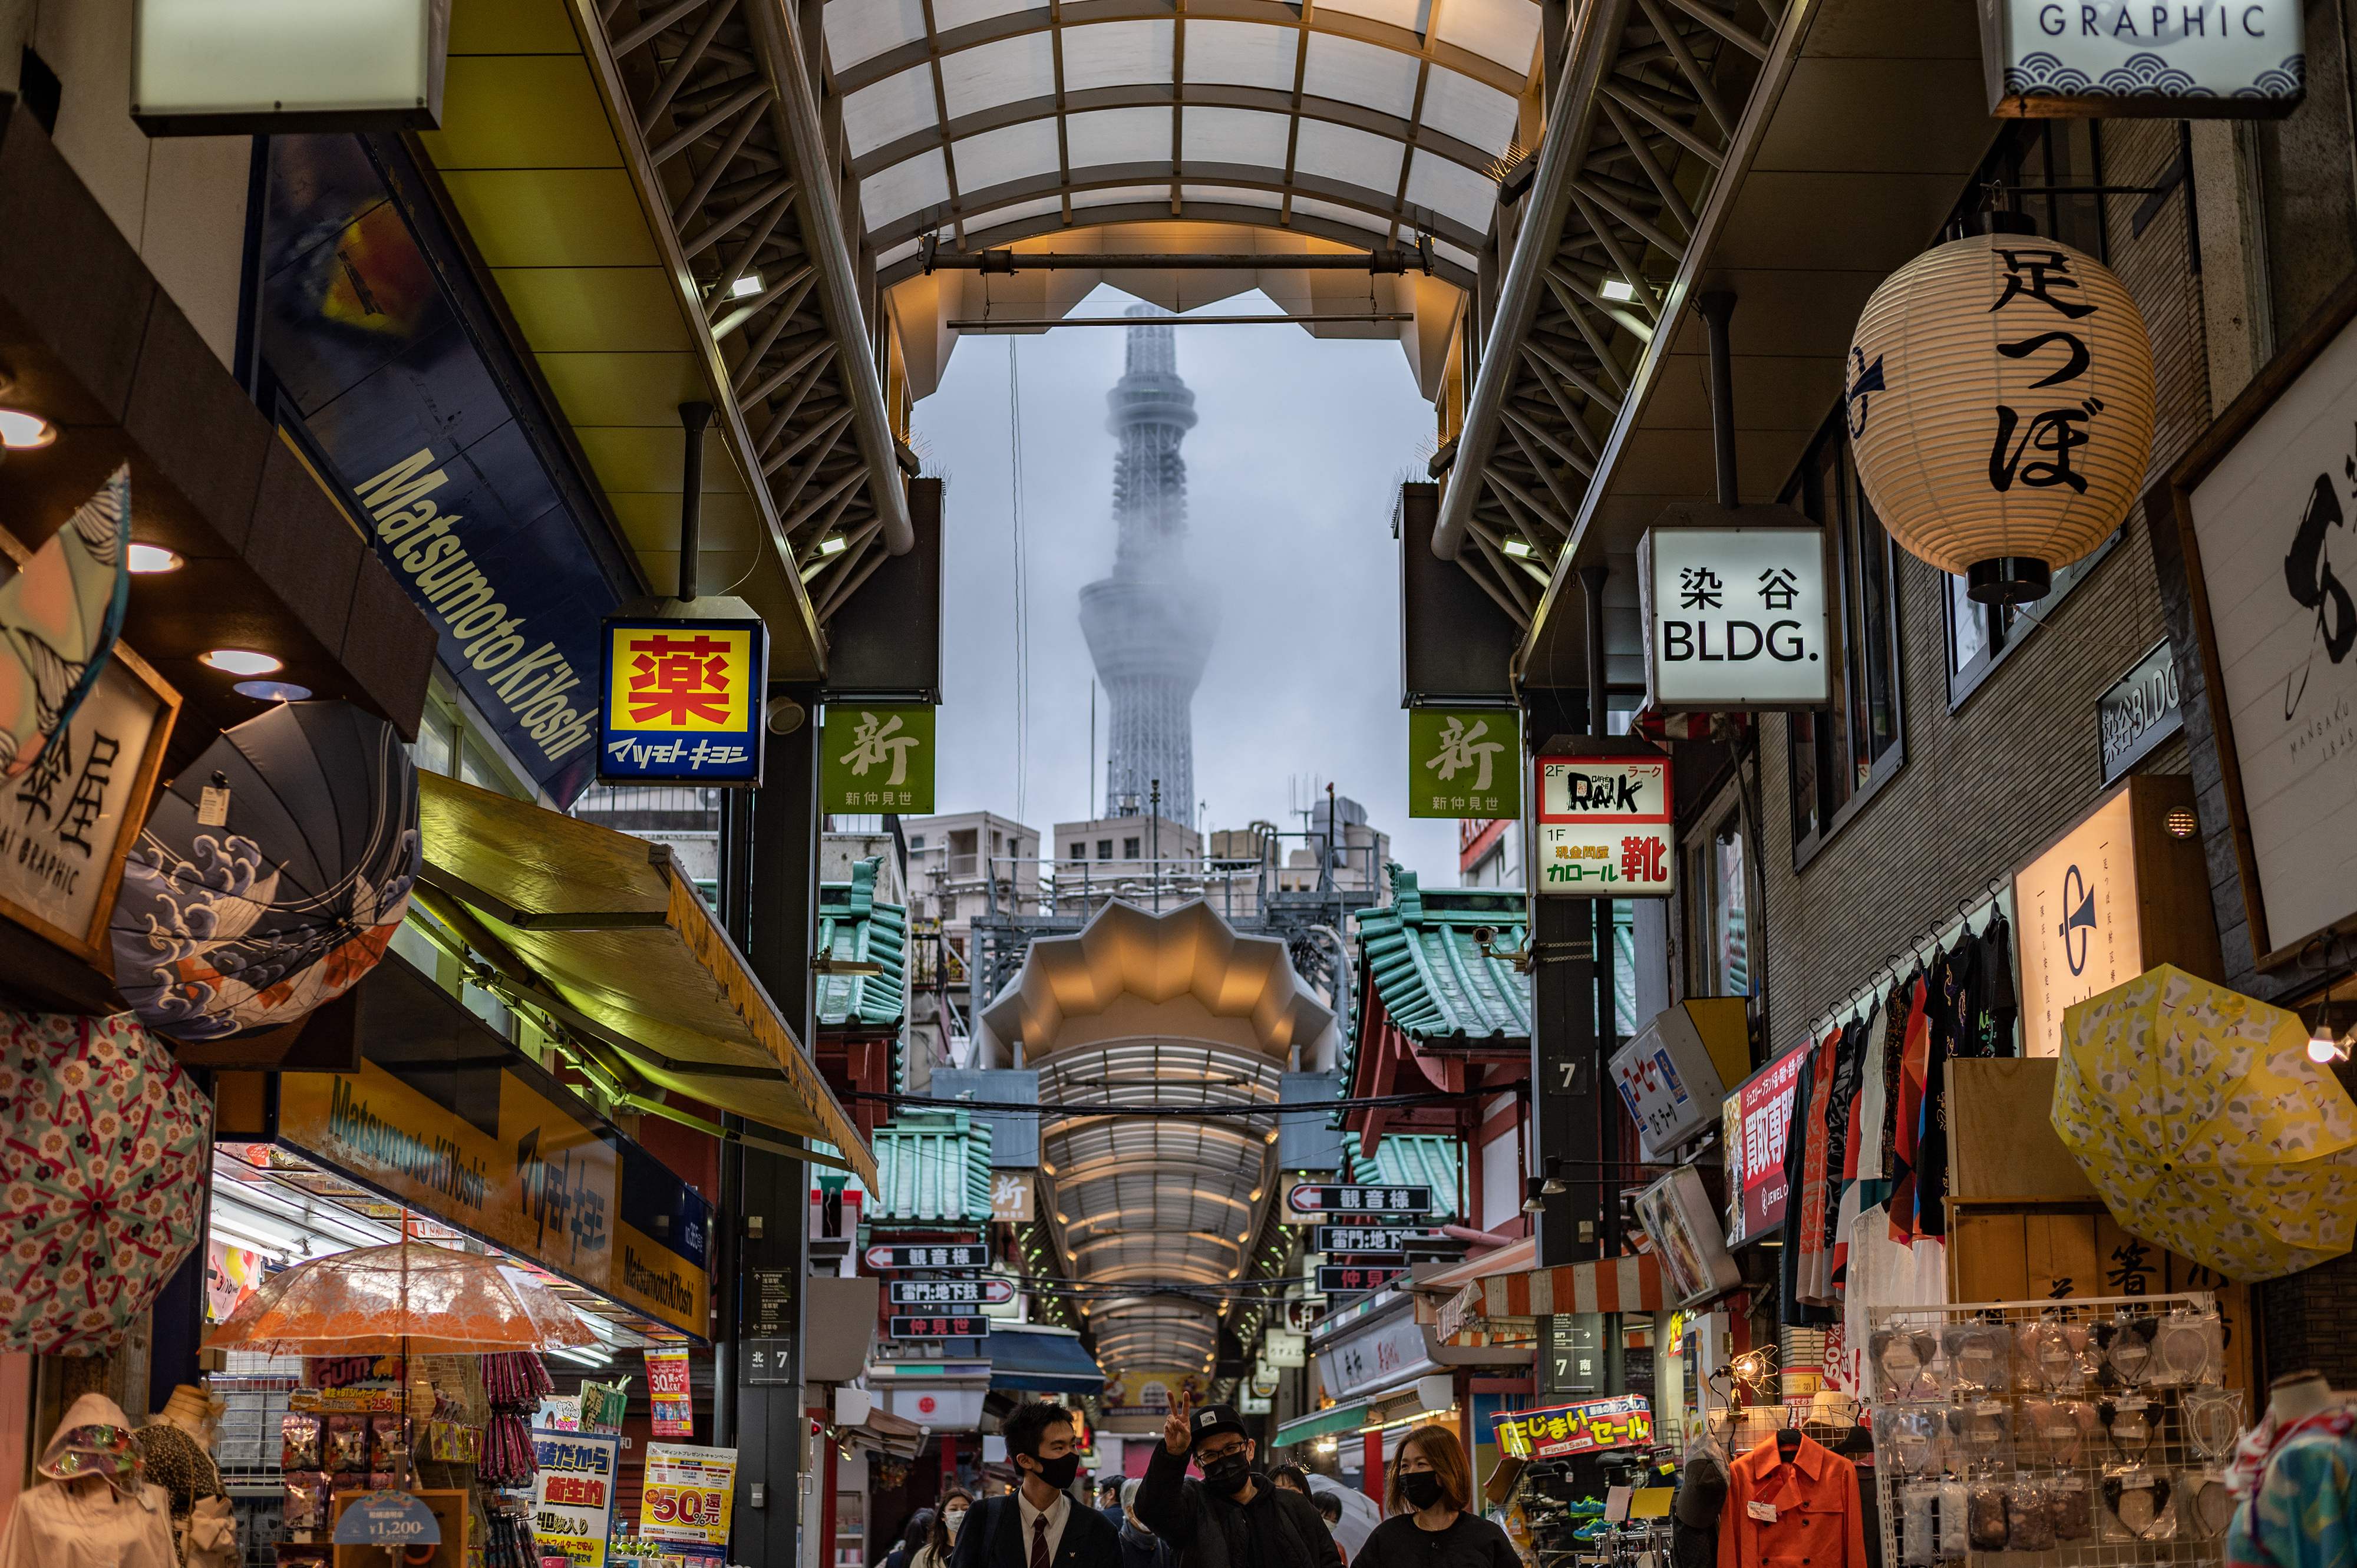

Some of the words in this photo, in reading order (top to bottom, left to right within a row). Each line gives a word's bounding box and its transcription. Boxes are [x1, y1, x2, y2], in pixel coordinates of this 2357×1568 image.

[2039, 4, 2266, 38] GRAPHIC
[1988, 249, 2104, 494] 足つぼ
[1663, 619, 1818, 662] BLDG.
[628, 635, 731, 725] 薬
[2290, 697, 2349, 764] MANSAKU
[840, 711, 920, 785] 新
[1426, 716, 1505, 791] 新
[1545, 765, 1565, 777] 2F
[1628, 766, 1662, 778] ラーク
[845, 791, 912, 806] 新仲見世
[1432, 796, 1498, 811] 新仲見世
[1547, 829, 1566, 841] 1F
[1555, 846, 1610, 859] 現金問屋
[1621, 836, 1668, 882] 靴
[18, 837, 80, 896] GRAPHIC
[1547, 864, 1619, 882] カロール
[1560, 1063, 1576, 1088] 7
[328, 1074, 431, 1181] Matsumoto
[990, 1174, 1028, 1209] 新
[1339, 1189, 1409, 1209] 観音様
[1768, 1186, 1782, 1205] JEWEL
[908, 1248, 970, 1266] 観音様
[902, 1283, 978, 1300] 雷門:地下鉄
[909, 1319, 970, 1335] 仲見世
[752, 1351, 764, 1363] 北
[777, 1351, 788, 1368] 7
[1556, 1359, 1567, 1376] 7
[1579, 1358, 1592, 1371] 南
[371, 1398, 394, 1412] 258
[1498, 1409, 1589, 1454] 店じまい
[1590, 1415, 1649, 1445] セール
[533, 1441, 610, 1473] 装だから
[1544, 1444, 1568, 1455] Final
[1569, 1440, 1589, 1450] Sale
[544, 1475, 606, 1510] 衛生的
[704, 1493, 722, 1525] 還元
[537, 1511, 589, 1536] 40枚入り
